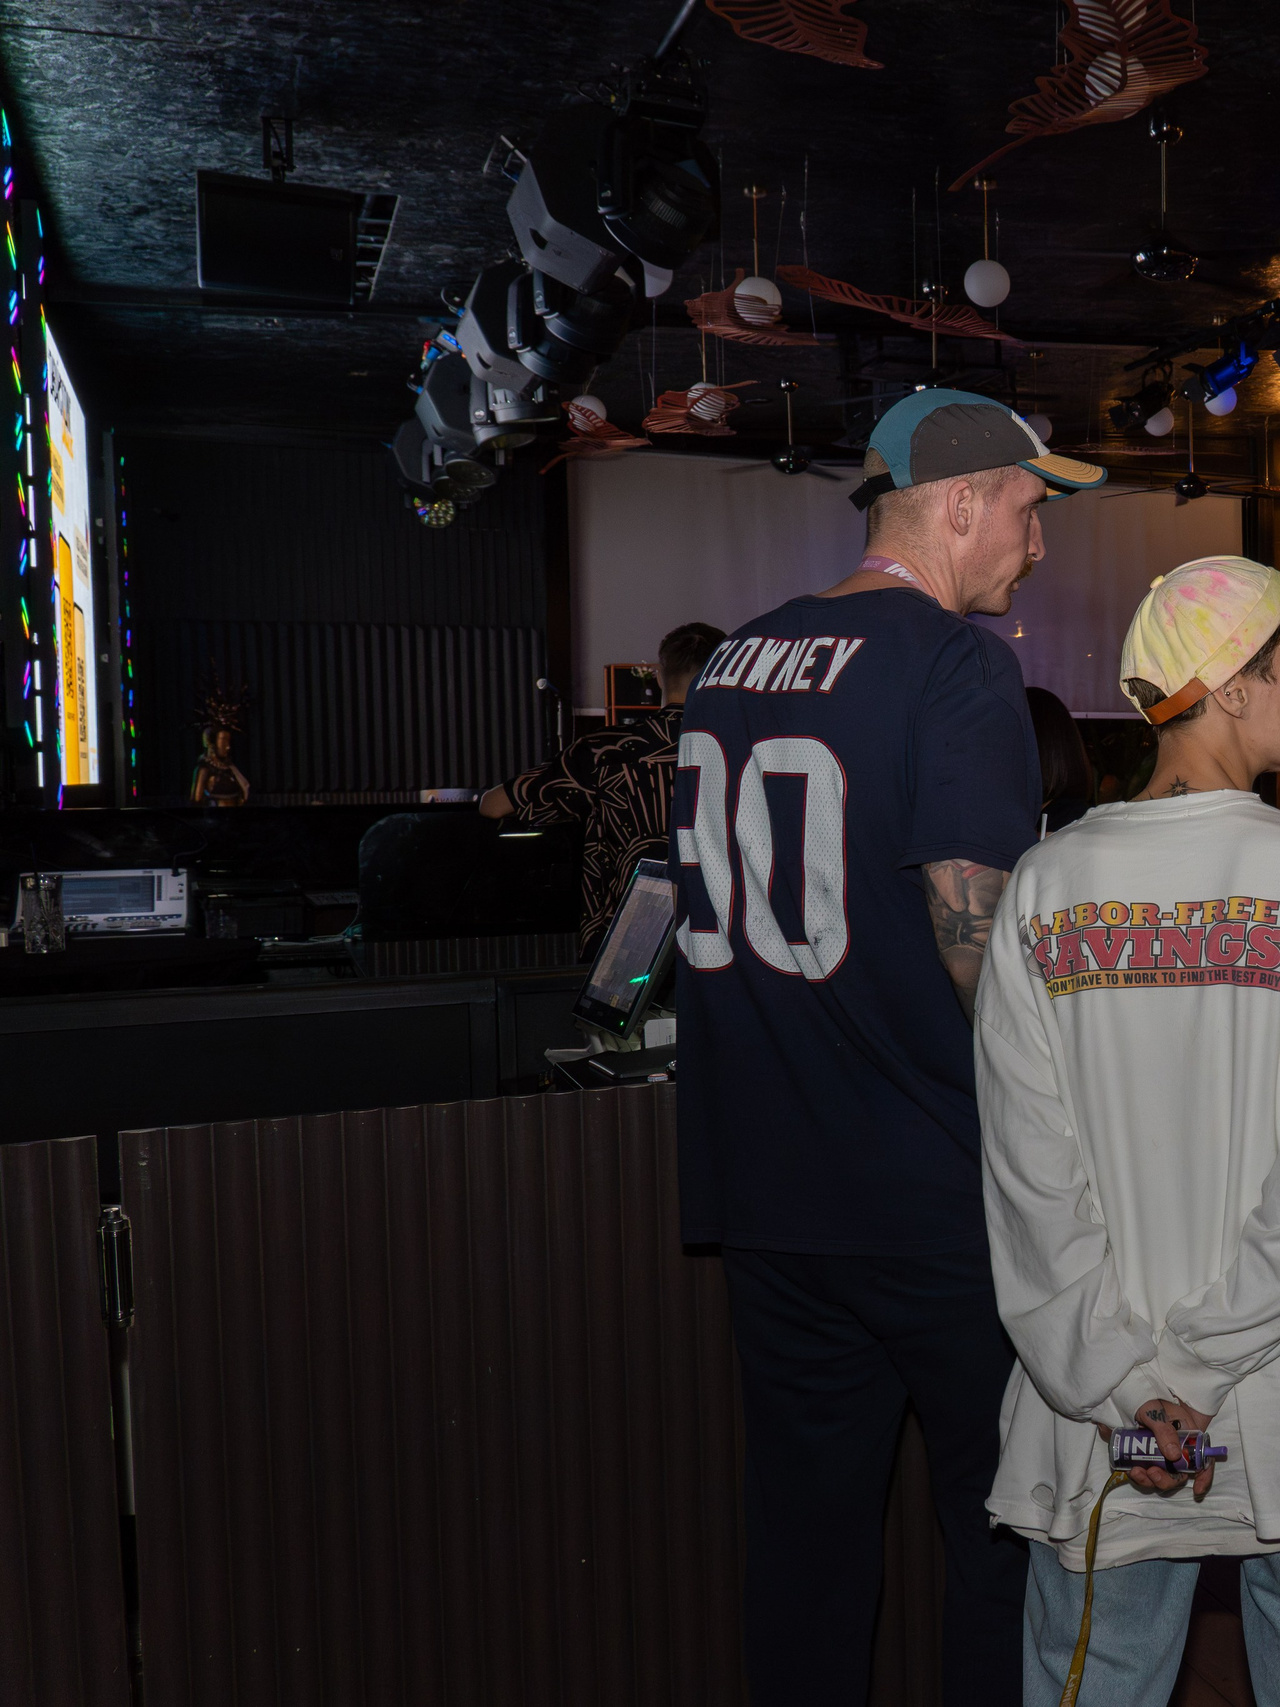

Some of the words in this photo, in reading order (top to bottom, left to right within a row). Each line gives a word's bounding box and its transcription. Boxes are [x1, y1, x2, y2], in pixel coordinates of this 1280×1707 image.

[696, 635, 867, 694] CLOWNEY
[1030, 896, 1280, 940] LABOR-FREE
[1048, 979, 1075, 994] ON'T
[1075, 973, 1102, 987] HAVE
[1105, 973, 1119, 985] TO
[1123, 972, 1158, 985] WORK
[1162, 971, 1176, 984] TO
[1180, 970, 1205, 983] FIND
[1207, 969, 1229, 982] THE
[1231, 969, 1256, 983] BEST
